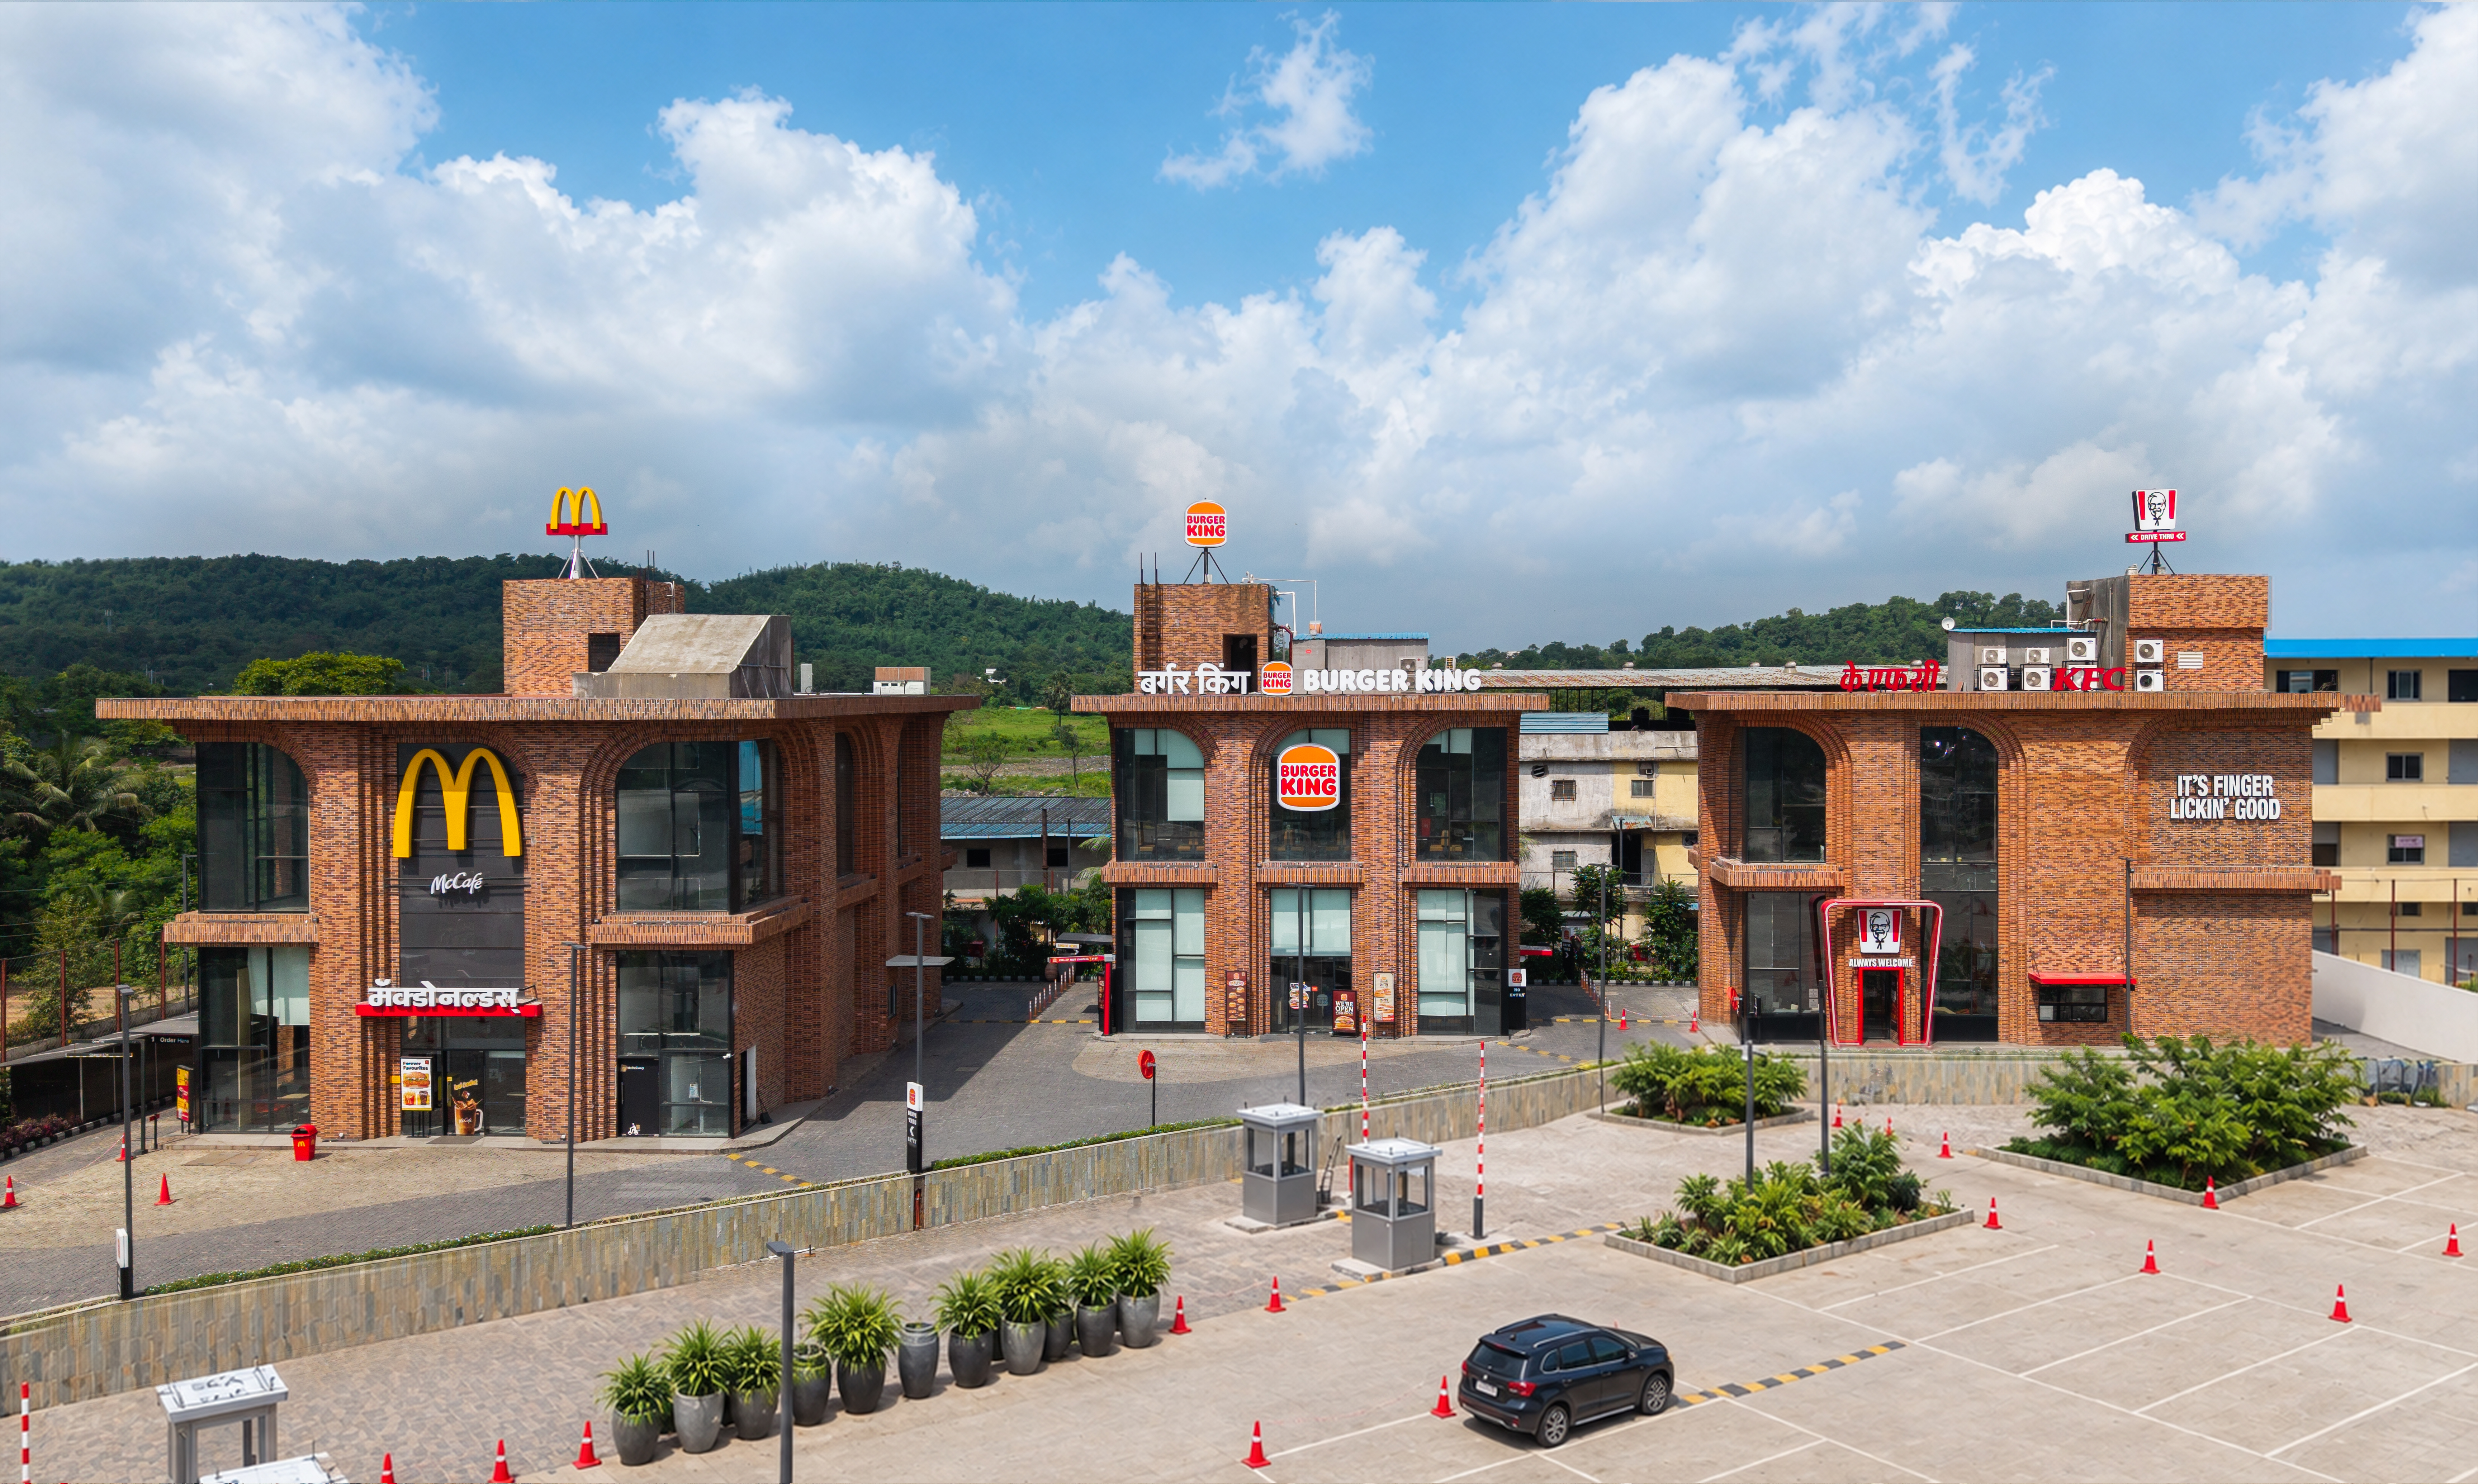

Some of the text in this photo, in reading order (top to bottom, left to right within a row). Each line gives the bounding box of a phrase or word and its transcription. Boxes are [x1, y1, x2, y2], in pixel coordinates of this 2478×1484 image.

[1187, 515, 1225, 524] BURGER
[1187, 524, 1226, 537] KING
[1138, 663, 1251, 695] बर्गर किंग
[1263, 679, 1291, 688] KING
[1303, 669, 1481, 691] BURGER KING
[2051, 667, 2126, 691] KFC
[1281, 765, 1337, 777] BURGER
[1281, 778, 1337, 795] KING
[2178, 775, 2273, 796] IT’S FINGER
[2170, 798, 2280, 819] LICKIN’ GOOD
[431, 872, 483, 894] McCafé
[1849, 959, 1913, 967] ALWAYS WELCOME
[908, 1110, 917, 1118] DRIVE
[908, 1136, 917, 1145] ENTRY
